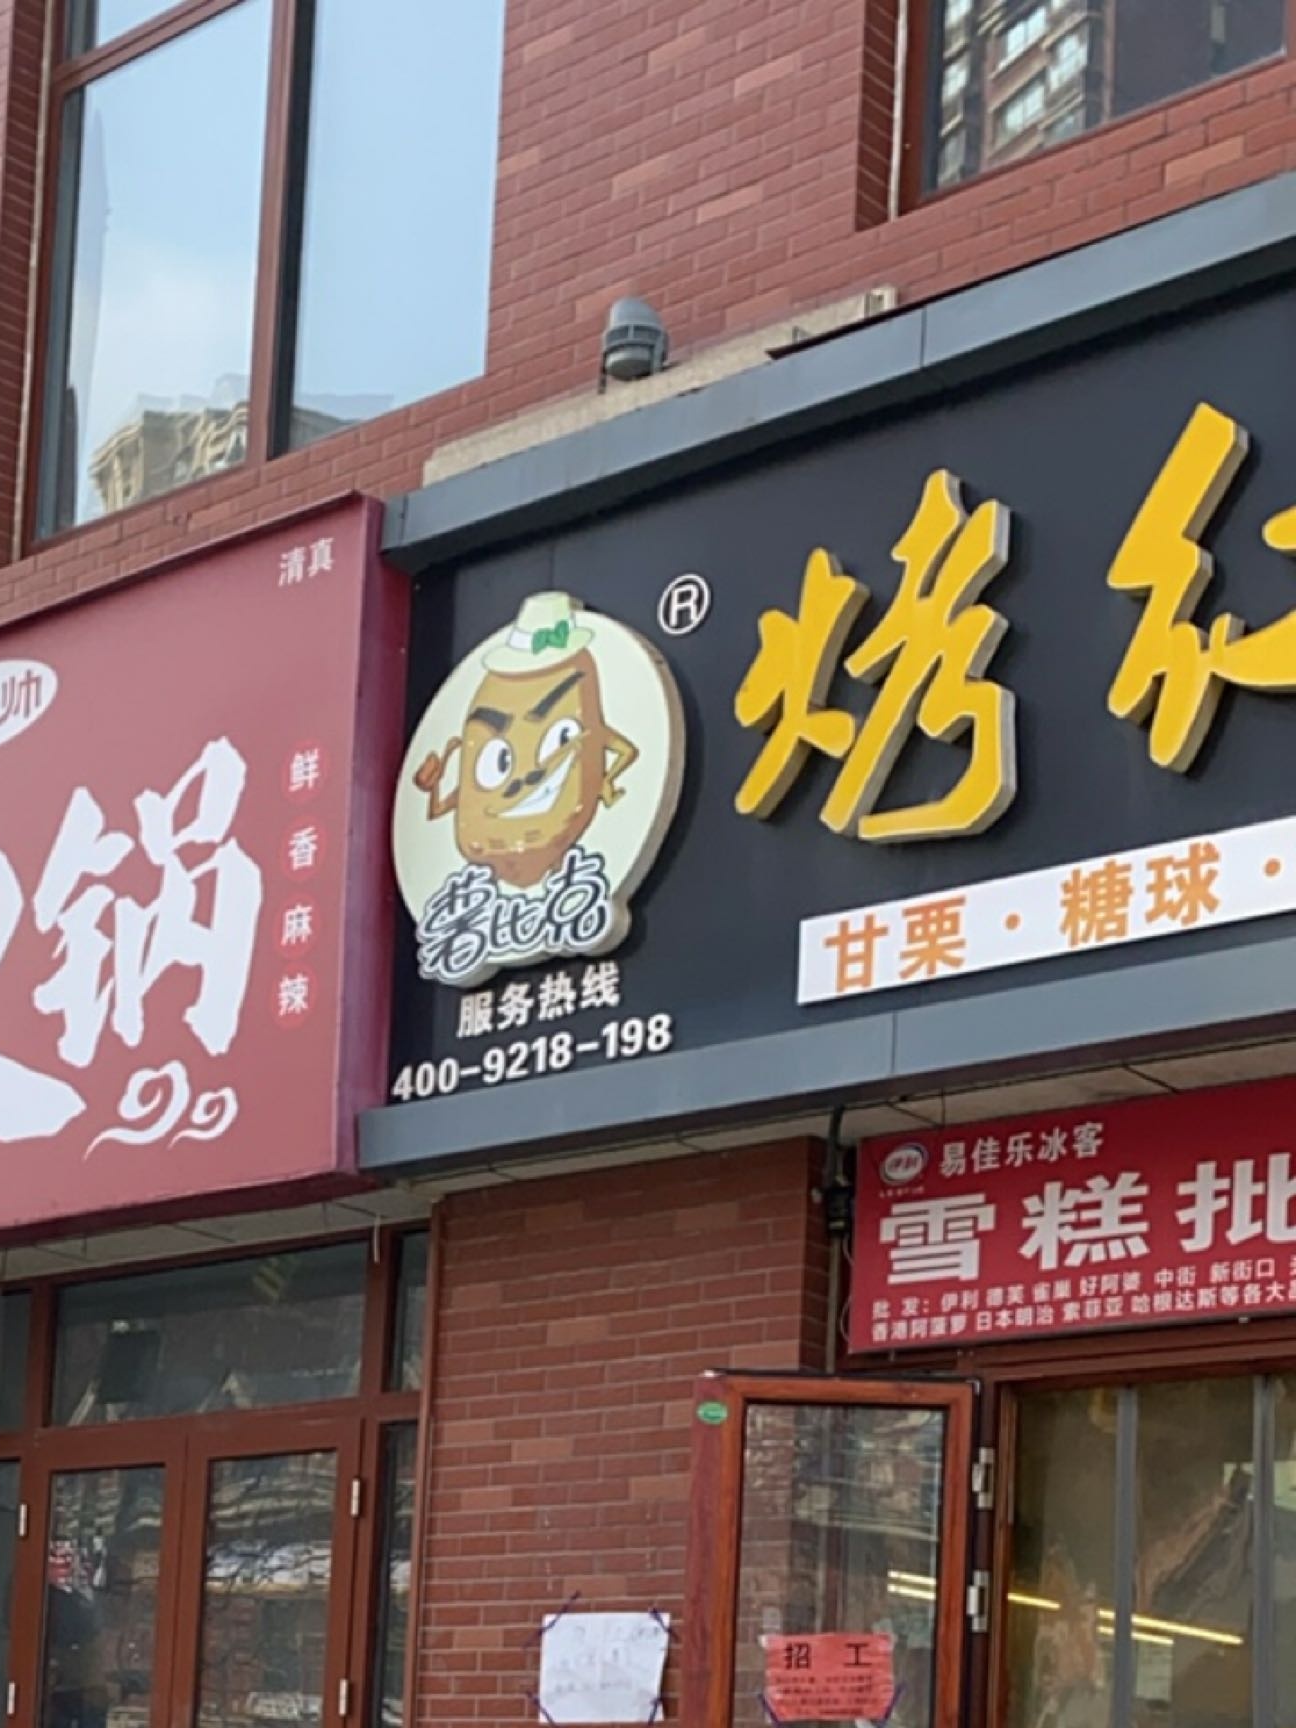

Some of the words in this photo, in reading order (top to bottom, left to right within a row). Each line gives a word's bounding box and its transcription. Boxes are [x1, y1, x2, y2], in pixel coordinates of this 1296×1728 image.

[278, 537, 334, 587] 清真
[457, 961, 620, 1038] 服务热线
[393, 1013, 673, 1101] 400-9218-198
[940, 1121, 1104, 1177] 易佳乐冰客
[879, 1152, 1296, 1284] 雪糕批
[1154, 1265, 1196, 1288] 中街
